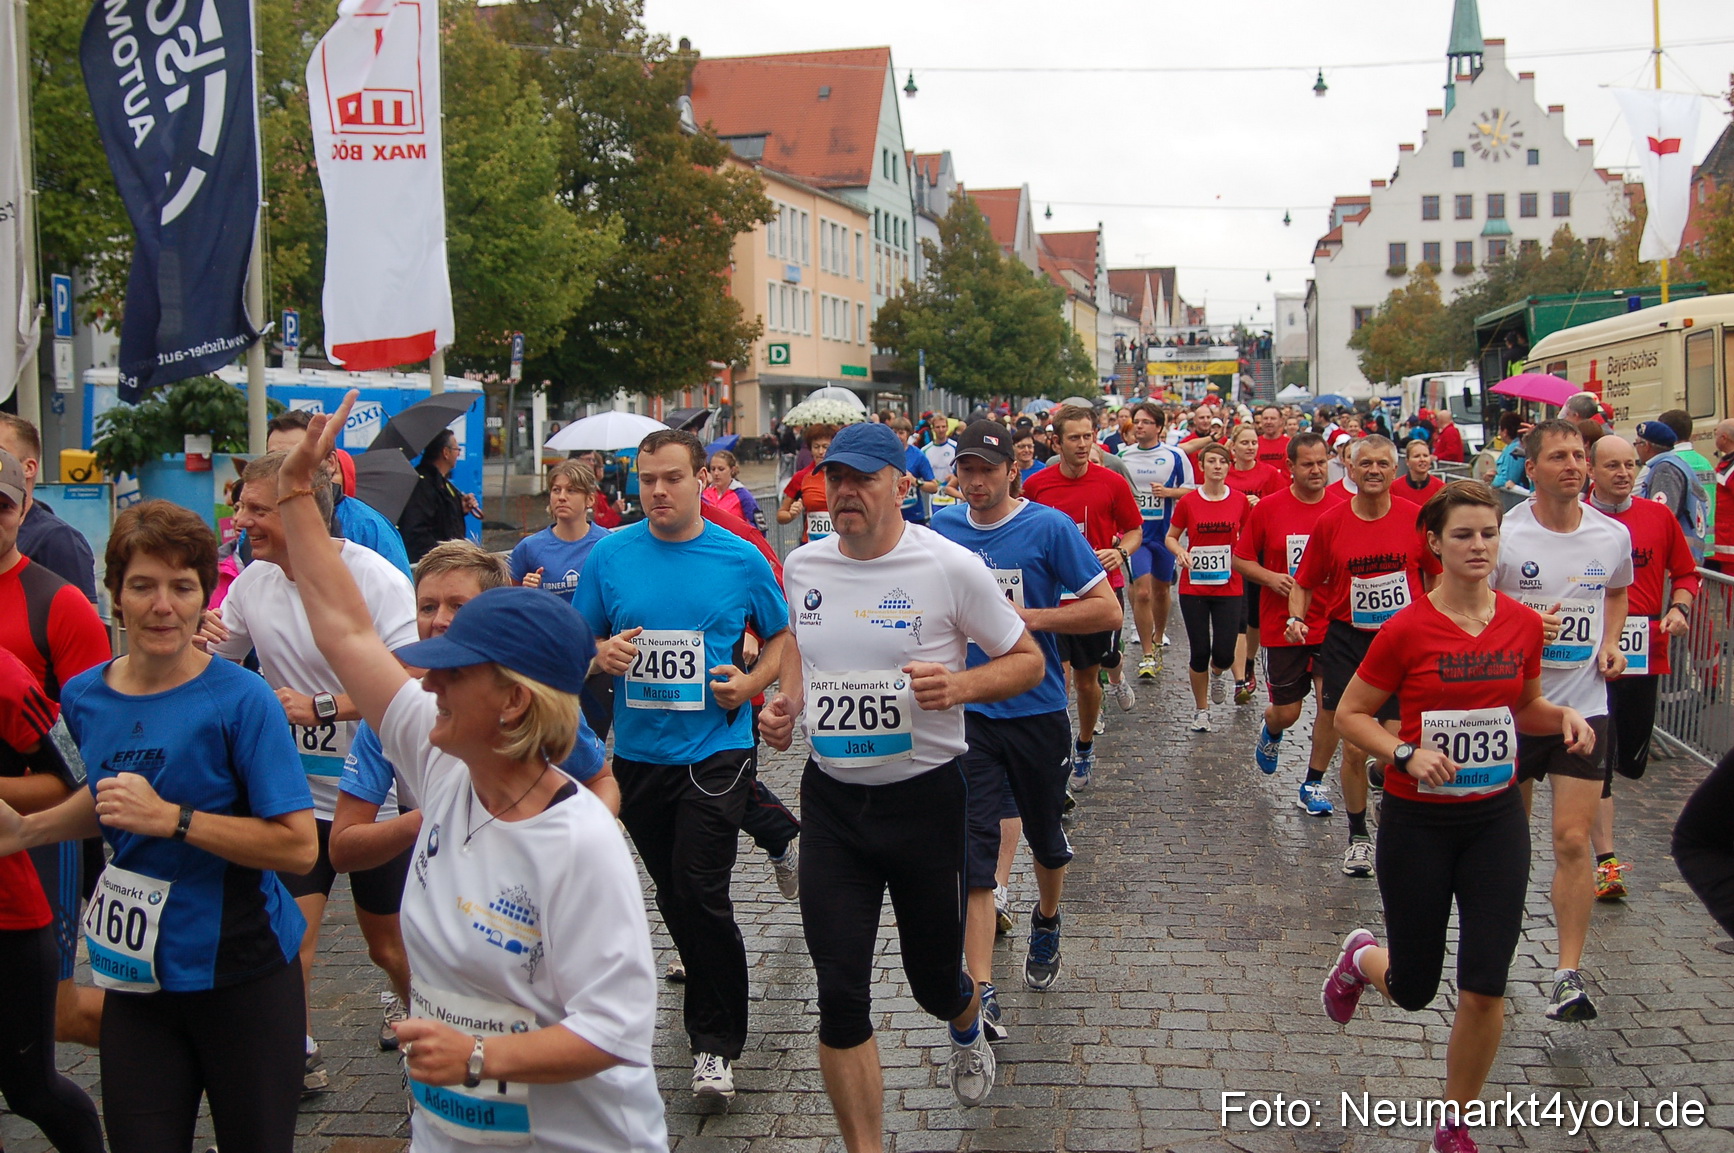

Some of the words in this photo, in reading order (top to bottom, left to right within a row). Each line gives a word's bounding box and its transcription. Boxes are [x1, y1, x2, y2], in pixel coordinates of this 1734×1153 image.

[771, 345, 787, 362] D
[1607, 348, 1658, 377] Bayerisches
[1607, 379, 1631, 398] Rotes
[1192, 555, 1226, 570] 2931
[1355, 586, 1405, 610] 2656
[1559, 616, 1591, 642] 20
[648, 638, 689, 646] Neumarkt
[1619, 631, 1643, 652] 50
[631, 650, 696, 680] 2463
[643, 686, 681, 699] Marcus
[810, 681, 840, 691] PARTL
[841, 680, 889, 691] Neumarkt
[817, 695, 901, 731] 2265
[1424, 719, 1457, 728] PARTL
[1459, 717, 1502, 728] Neumarkt
[112, 748, 166, 763] ERTEL
[844, 740, 875, 754] Jack
[1431, 729, 1509, 764] 3033
[1455, 771, 1489, 785] andra
[436, 1006, 504, 1033] Neumarkt
[425, 1086, 495, 1126] Adelheid
